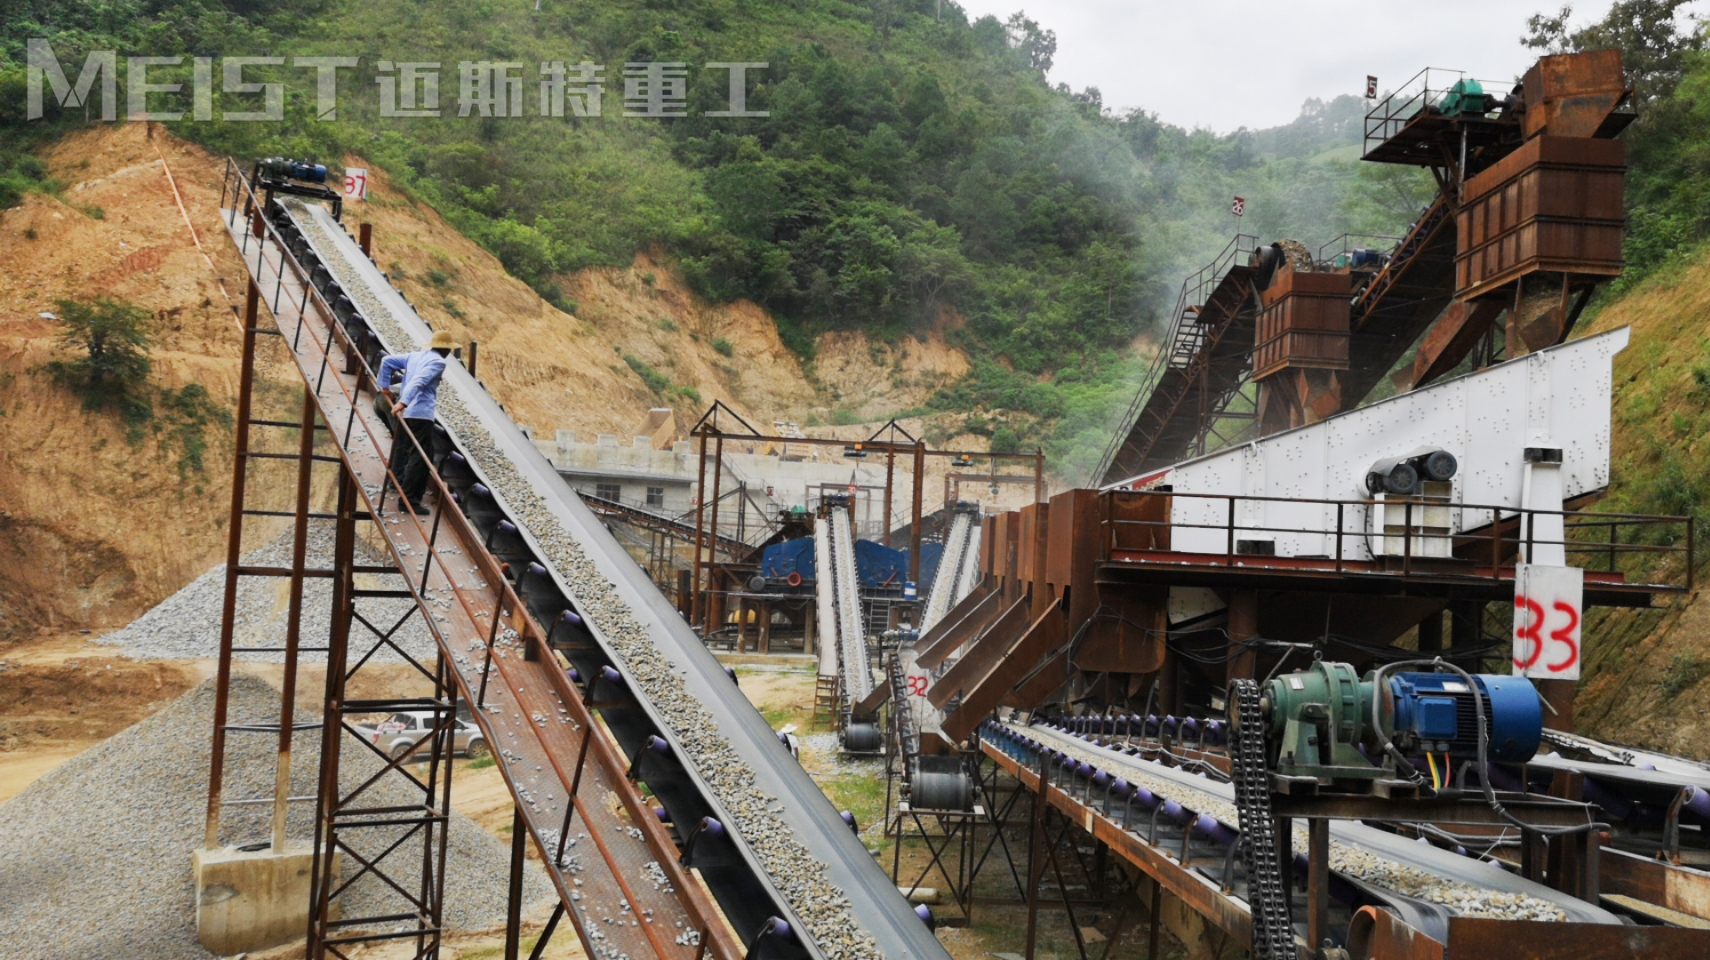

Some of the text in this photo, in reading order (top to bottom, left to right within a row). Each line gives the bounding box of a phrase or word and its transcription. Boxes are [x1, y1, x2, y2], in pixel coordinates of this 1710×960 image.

[1369, 80, 1377, 97] 5
[345, 175, 366, 197] 37
[1233, 200, 1244, 215] 26
[1513, 595, 1578, 672] 33
[907, 676, 929, 698] 32
